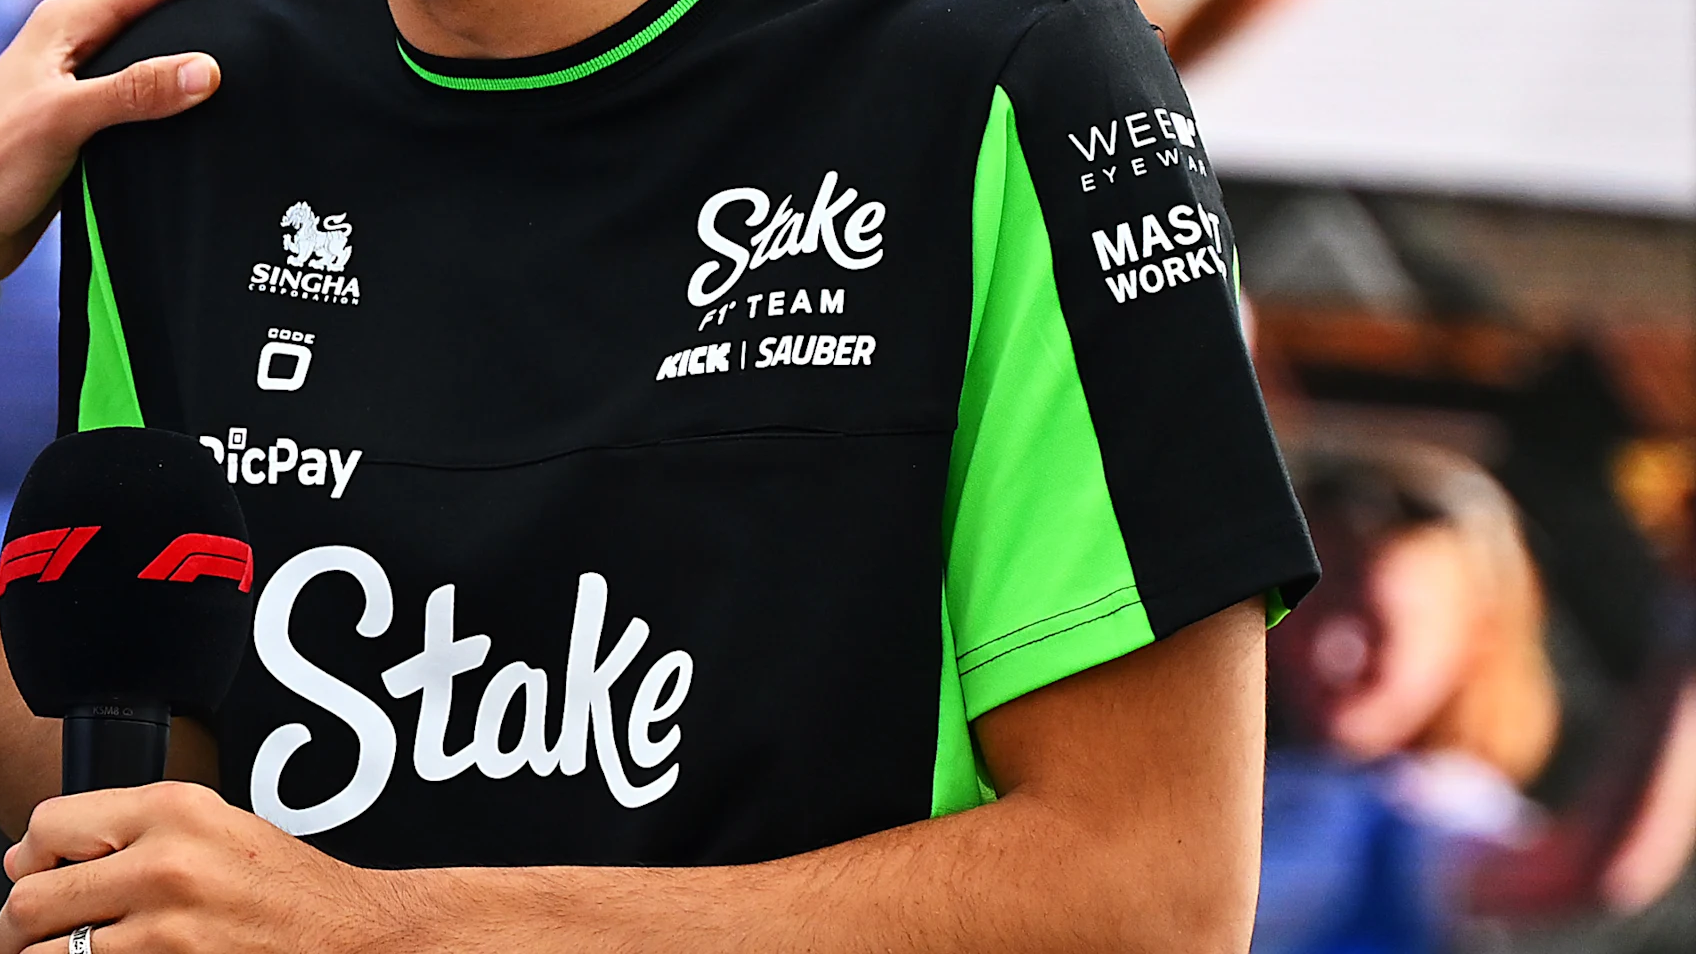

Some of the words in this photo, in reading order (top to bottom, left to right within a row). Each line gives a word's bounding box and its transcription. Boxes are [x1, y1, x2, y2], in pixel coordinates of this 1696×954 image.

[687, 171, 886, 307] Stake
[248, 283, 359, 305] CORPORATION
[250, 263, 360, 297] SINGHA
[698, 302, 729, 332] F1
[747, 289, 845, 318] TEAM
[268, 328, 315, 344] CODE
[656, 342, 731, 381] KICK
[755, 335, 876, 368] SAUBER
[137, 533, 252, 593] F1
[250, 545, 693, 837] Stake
